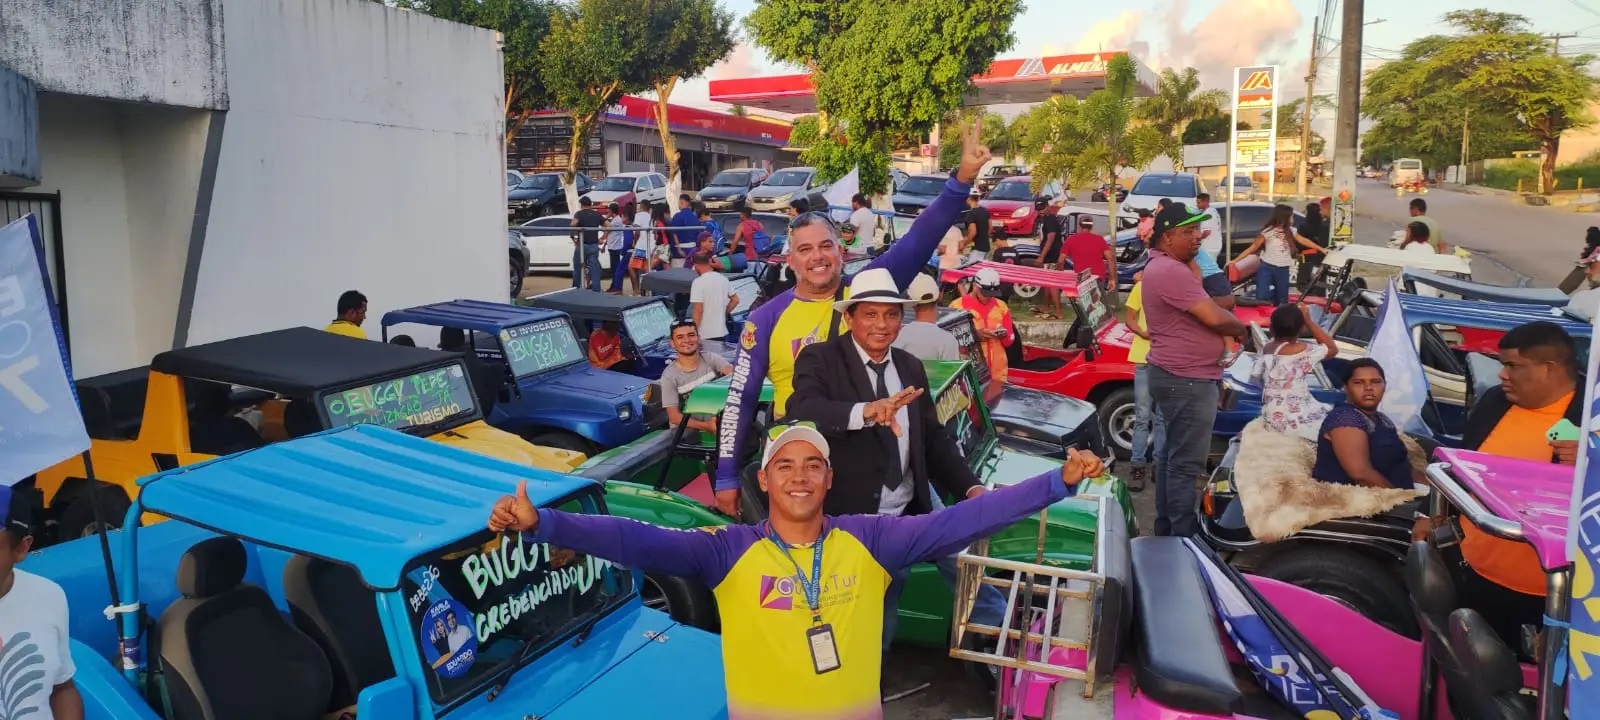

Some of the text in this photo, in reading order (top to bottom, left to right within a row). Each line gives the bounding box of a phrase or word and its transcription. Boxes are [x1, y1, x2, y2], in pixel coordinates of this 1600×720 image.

[507, 331, 553, 362] BUGGY
[731, 350, 752, 392] BUGGY
[330, 400, 345, 414] O
[342, 380, 404, 417] BUGGY
[406, 402, 460, 426] TURISMO
[728, 389, 742, 405] DE
[719, 405, 740, 458] PASSEIOS
